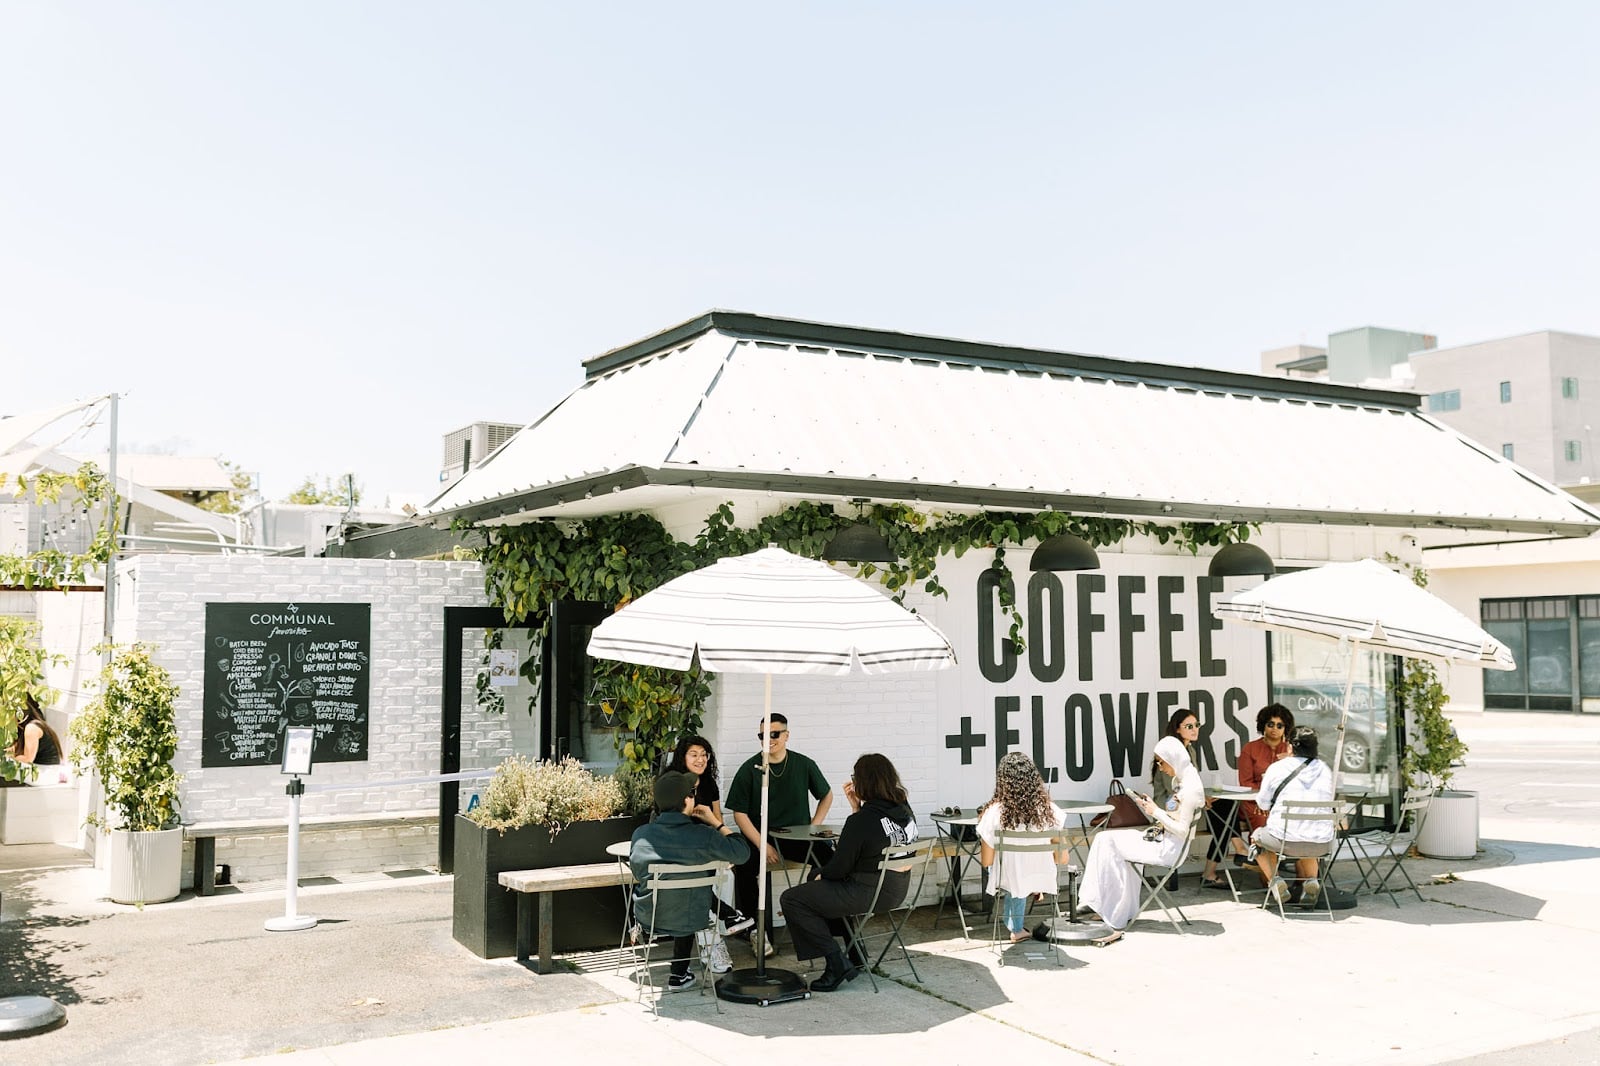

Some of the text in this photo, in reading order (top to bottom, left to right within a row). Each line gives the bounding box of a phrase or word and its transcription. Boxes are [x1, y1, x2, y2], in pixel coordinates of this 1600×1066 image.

[250, 613, 335, 625] COMMUNAL
[977, 567, 1227, 683] COFFEE
[309, 640, 360, 652] AVOCADO TOAST
[306, 652, 336, 663] GRANOLA
[227, 671, 262, 680] AMERICANO
[258, 715, 276, 723] LATTE
